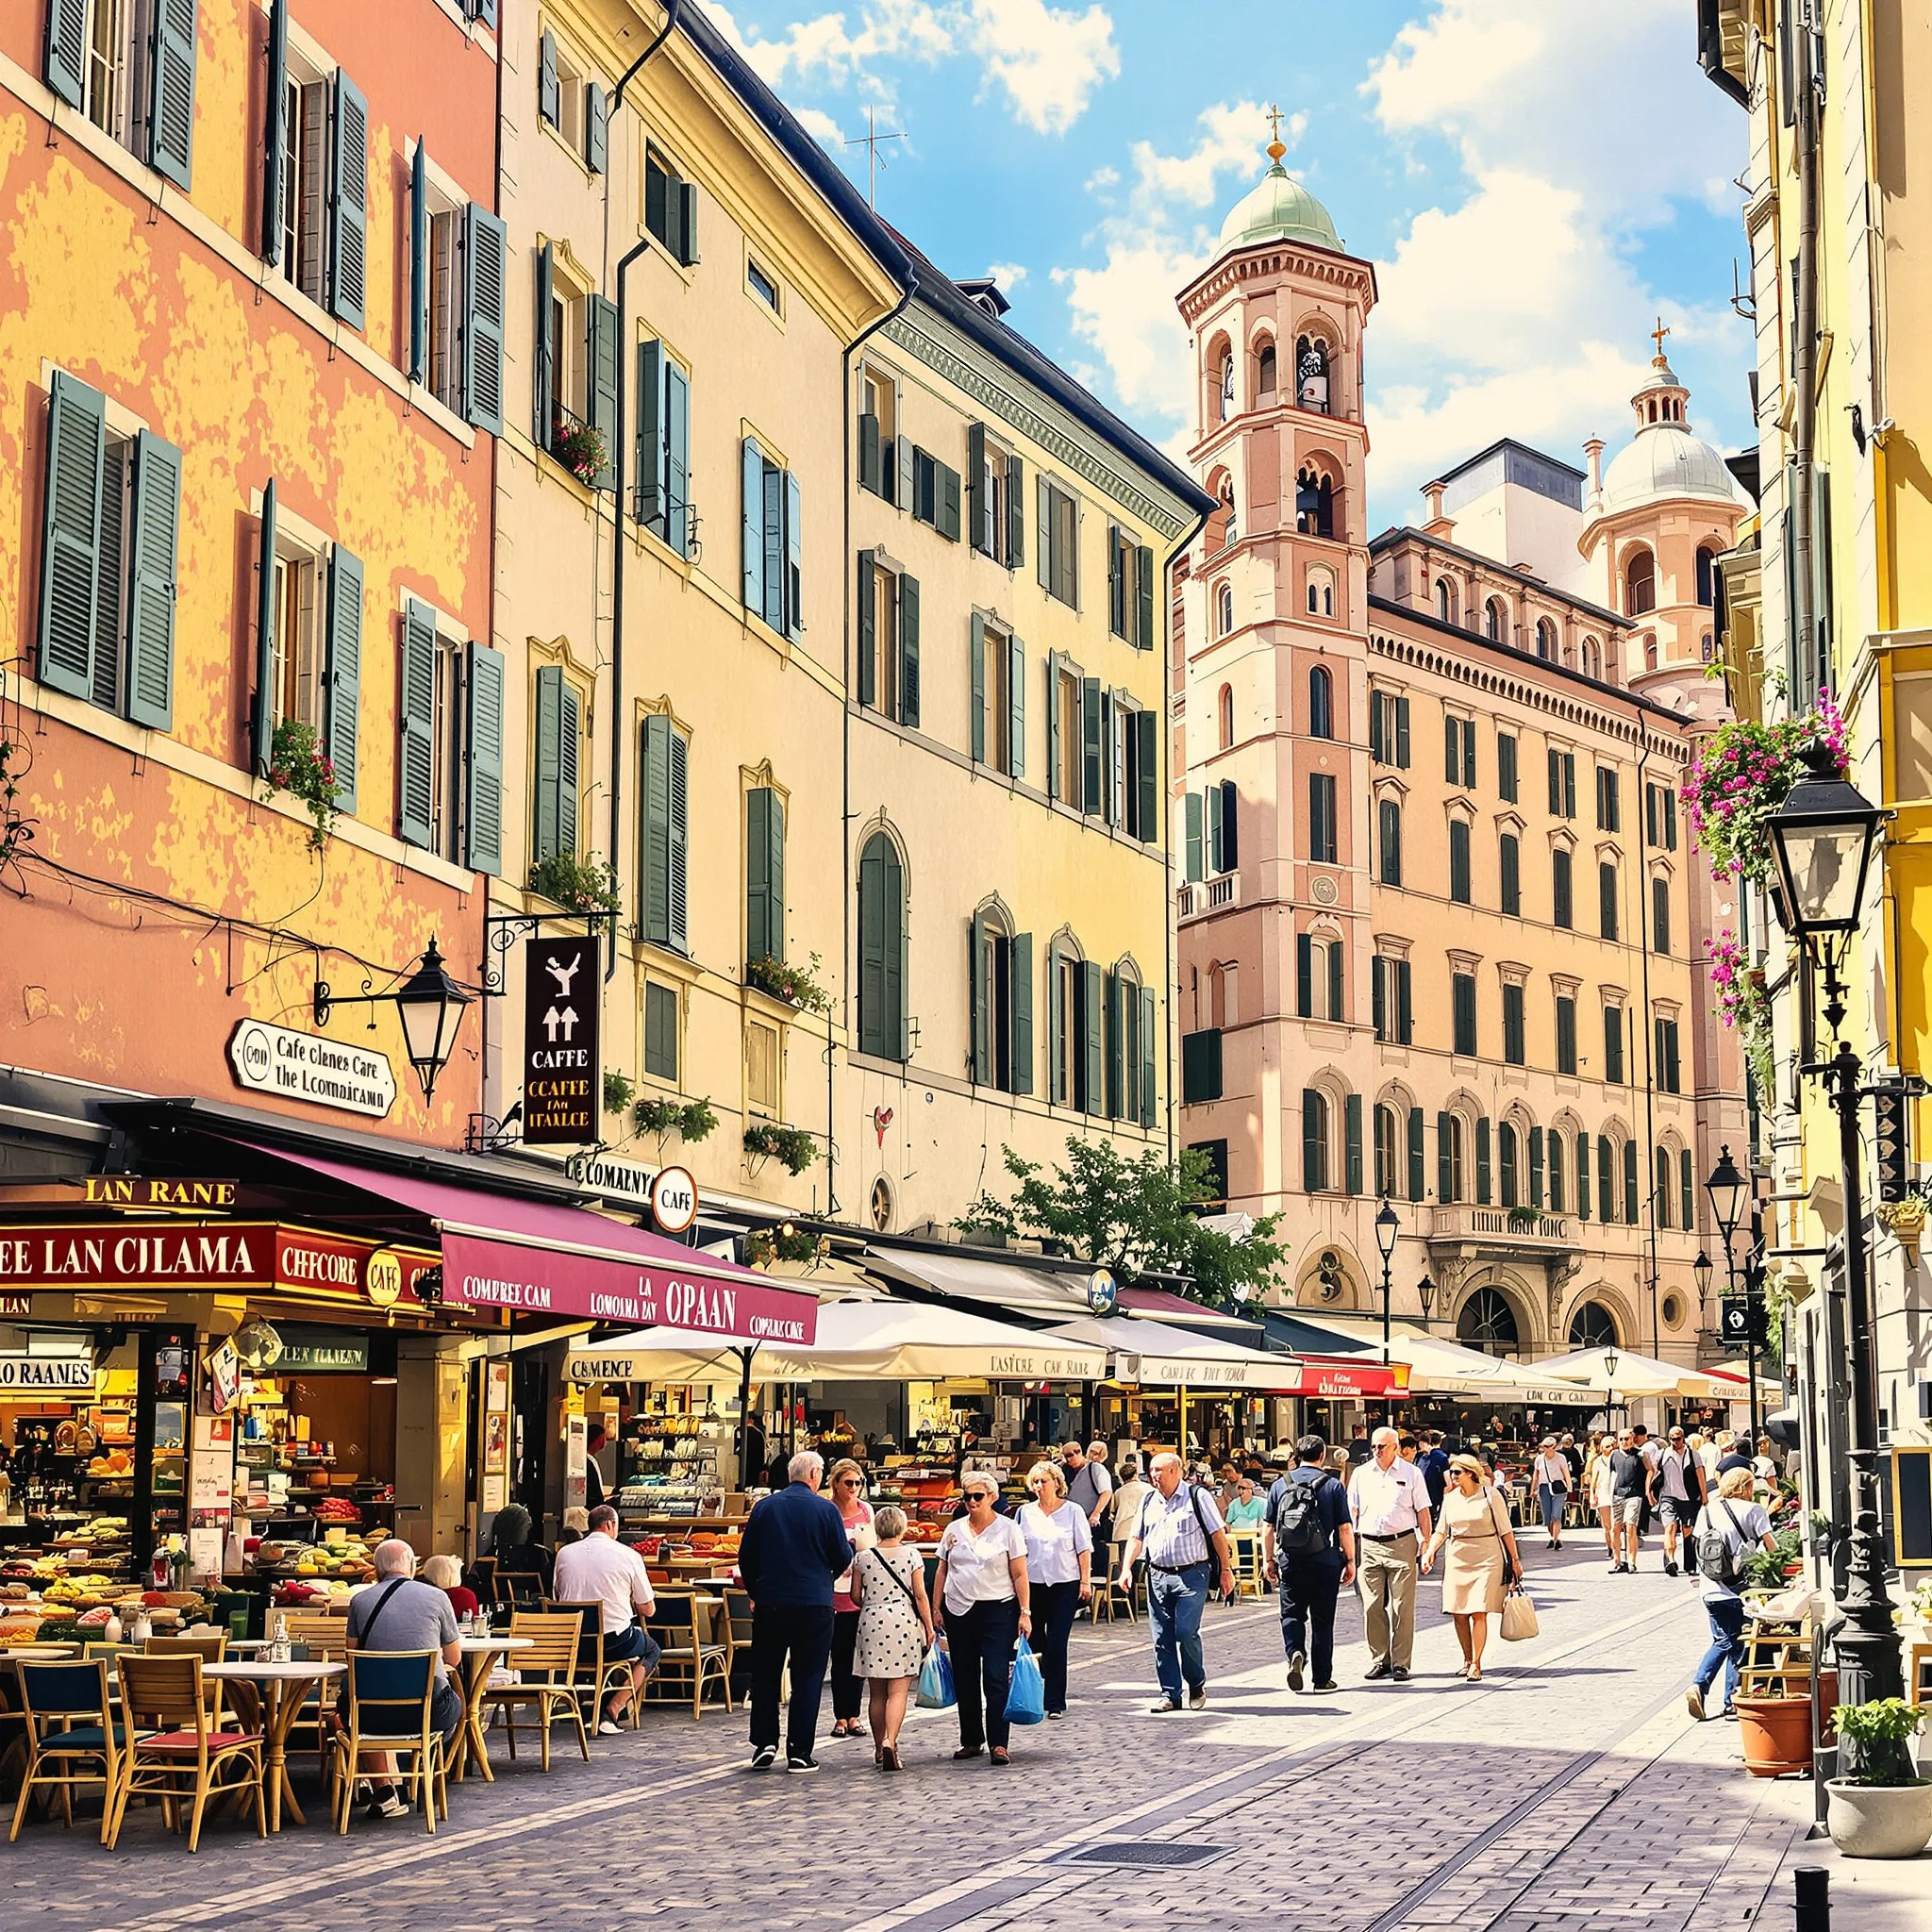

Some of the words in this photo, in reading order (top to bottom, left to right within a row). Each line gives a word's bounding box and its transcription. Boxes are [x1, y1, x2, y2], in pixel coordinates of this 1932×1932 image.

[276, 1036, 306, 1061] Cafe
[531, 1049, 589, 1069] CAFFE
[85, 1179, 136, 1202] LAN
[148, 1181, 236, 1205] RANE
[661, 1190, 691, 1211] CAFE
[43, 1239, 106, 1274] LAN
[524, 1284, 551, 1307] CAM
[639, 1275, 652, 1298] LA
[665, 1280, 737, 1331] OPAAN
